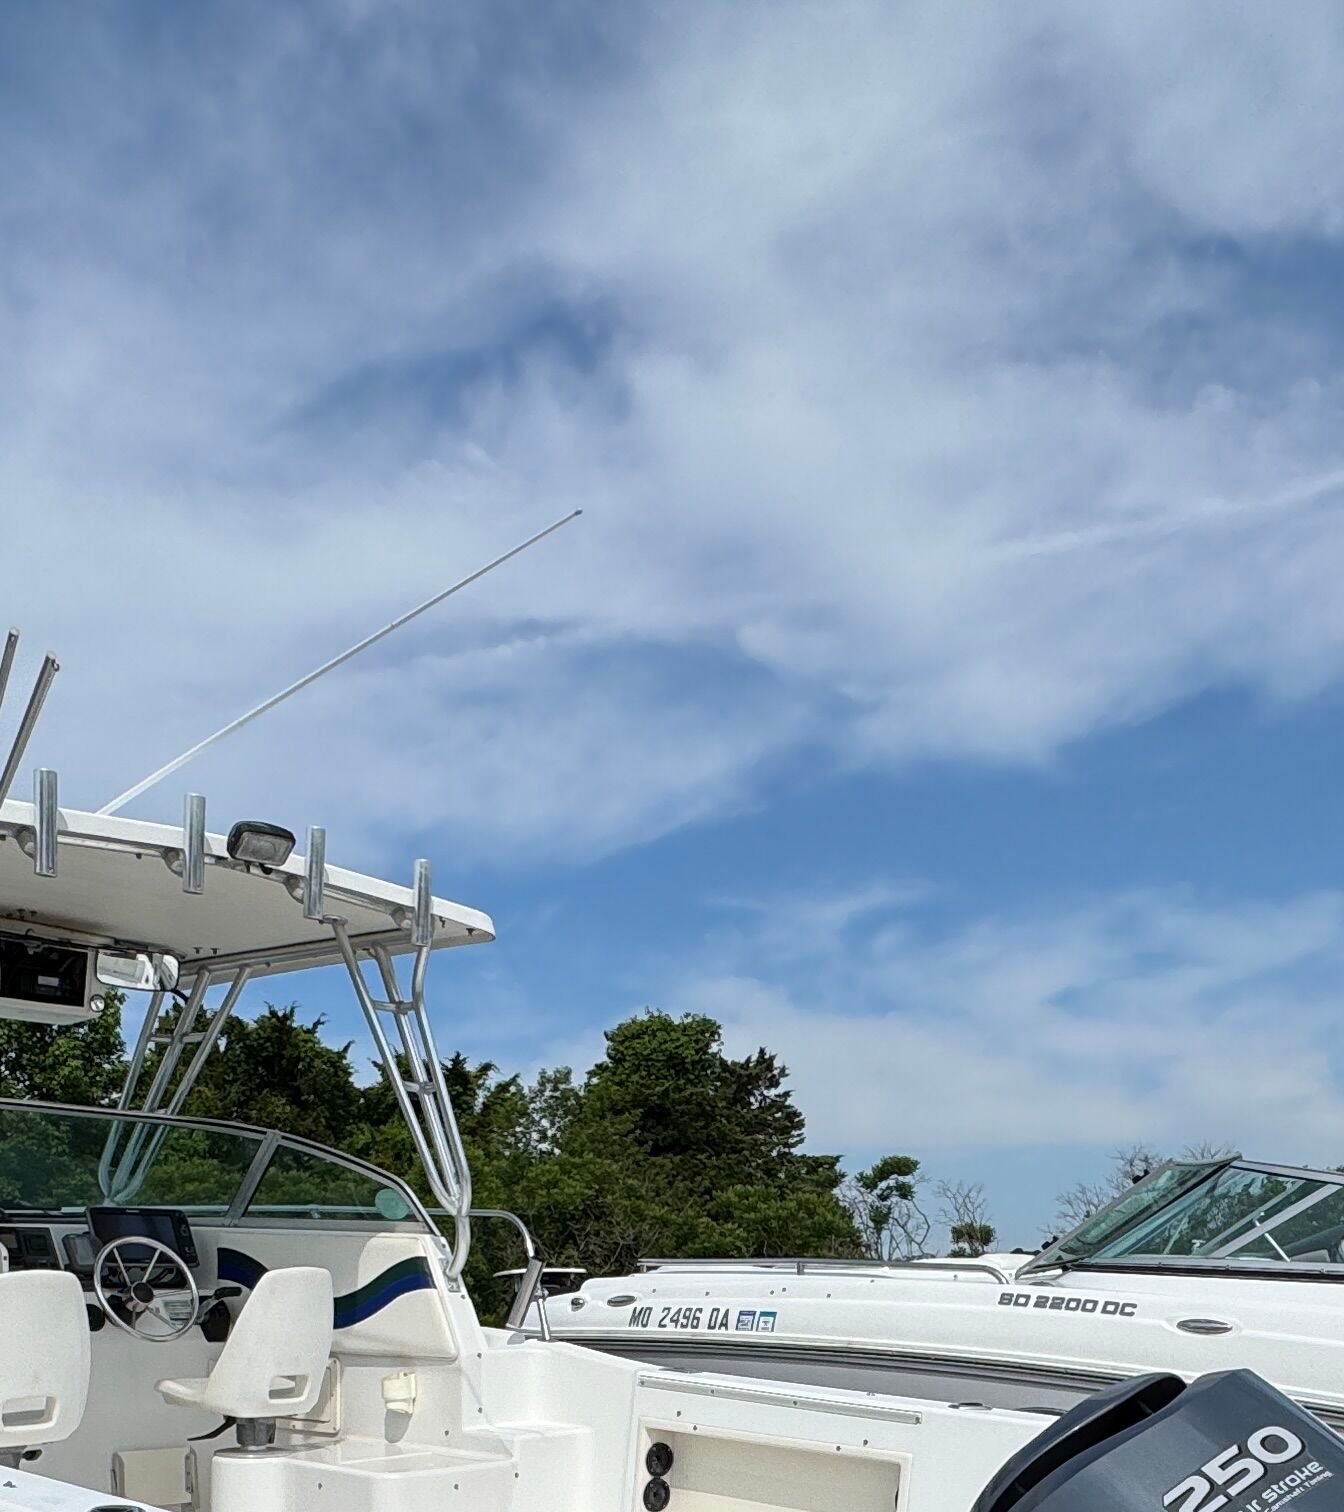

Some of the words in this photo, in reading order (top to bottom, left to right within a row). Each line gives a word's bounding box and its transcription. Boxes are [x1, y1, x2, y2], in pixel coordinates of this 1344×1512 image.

[1032, 1294, 1099, 1313] 2200
[1100, 1300, 1139, 1317] DC
[657, 1306, 703, 1330] 2496
